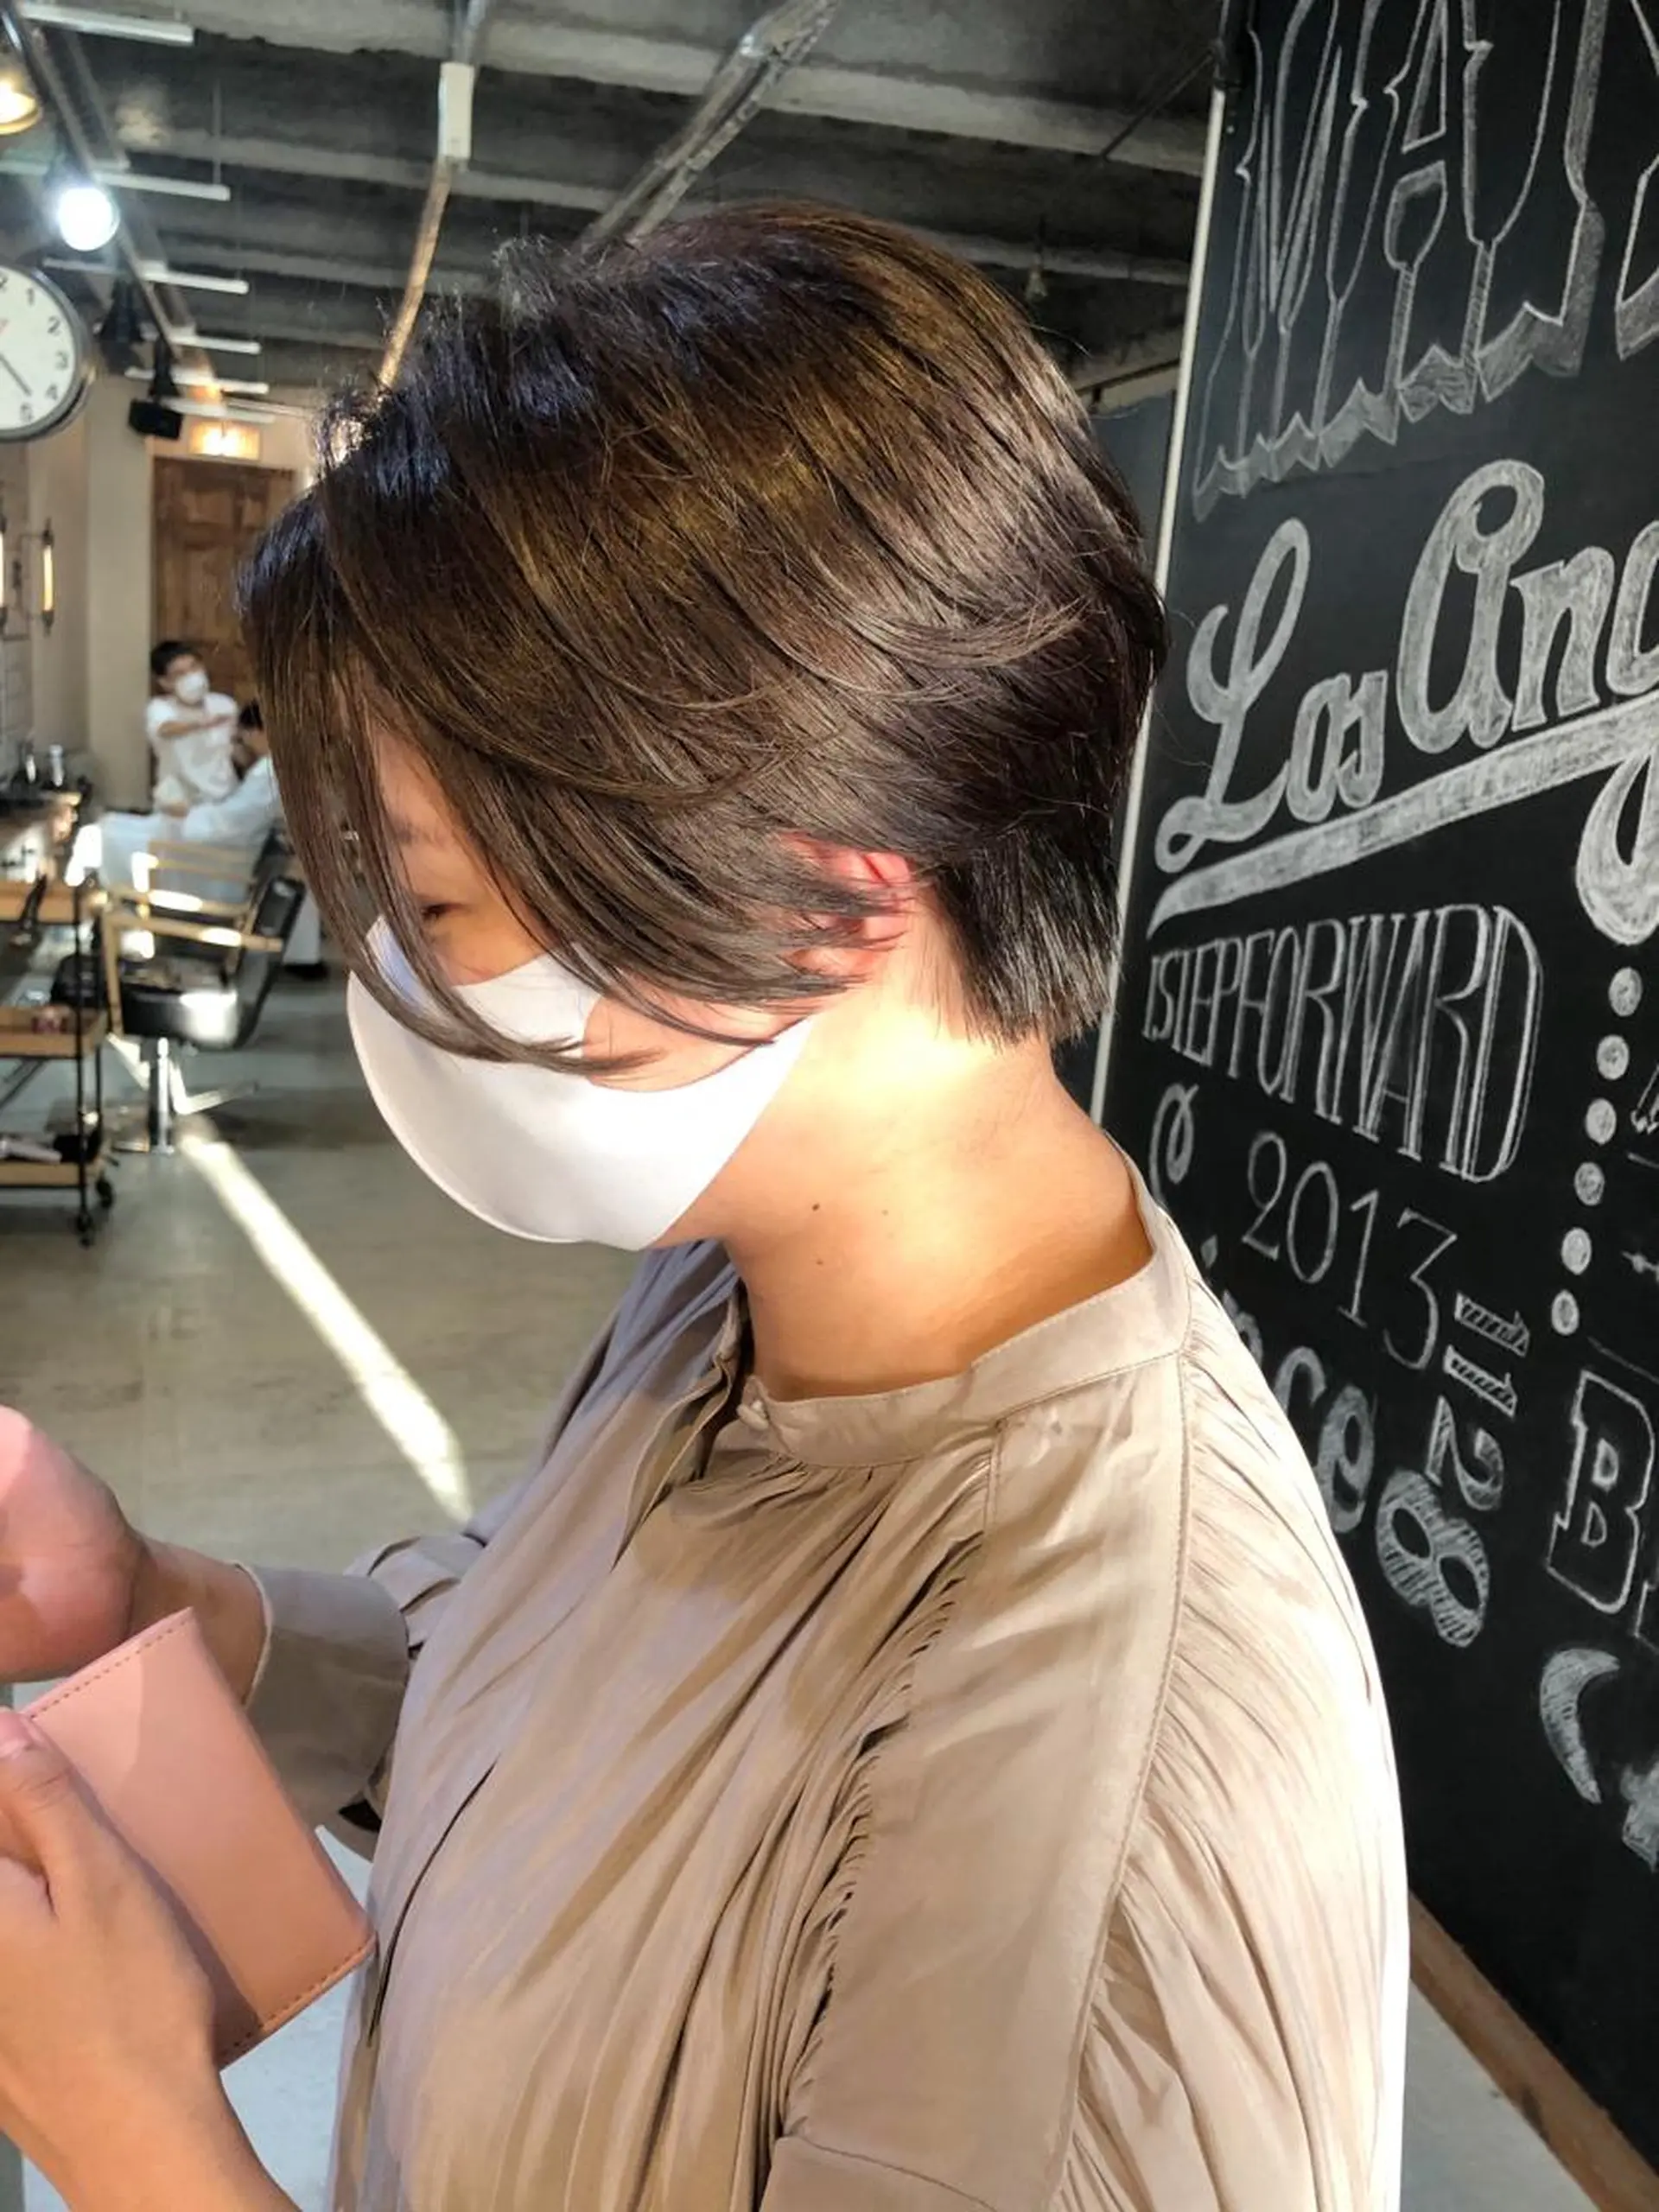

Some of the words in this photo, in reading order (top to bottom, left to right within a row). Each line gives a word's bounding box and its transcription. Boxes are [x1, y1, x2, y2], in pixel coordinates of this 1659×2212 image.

[27, 287, 35, 307] 1
[48, 315, 61, 336] 2
[1155, 518, 1388, 874] Los
[1243, 1130, 1457, 1370] 2013
